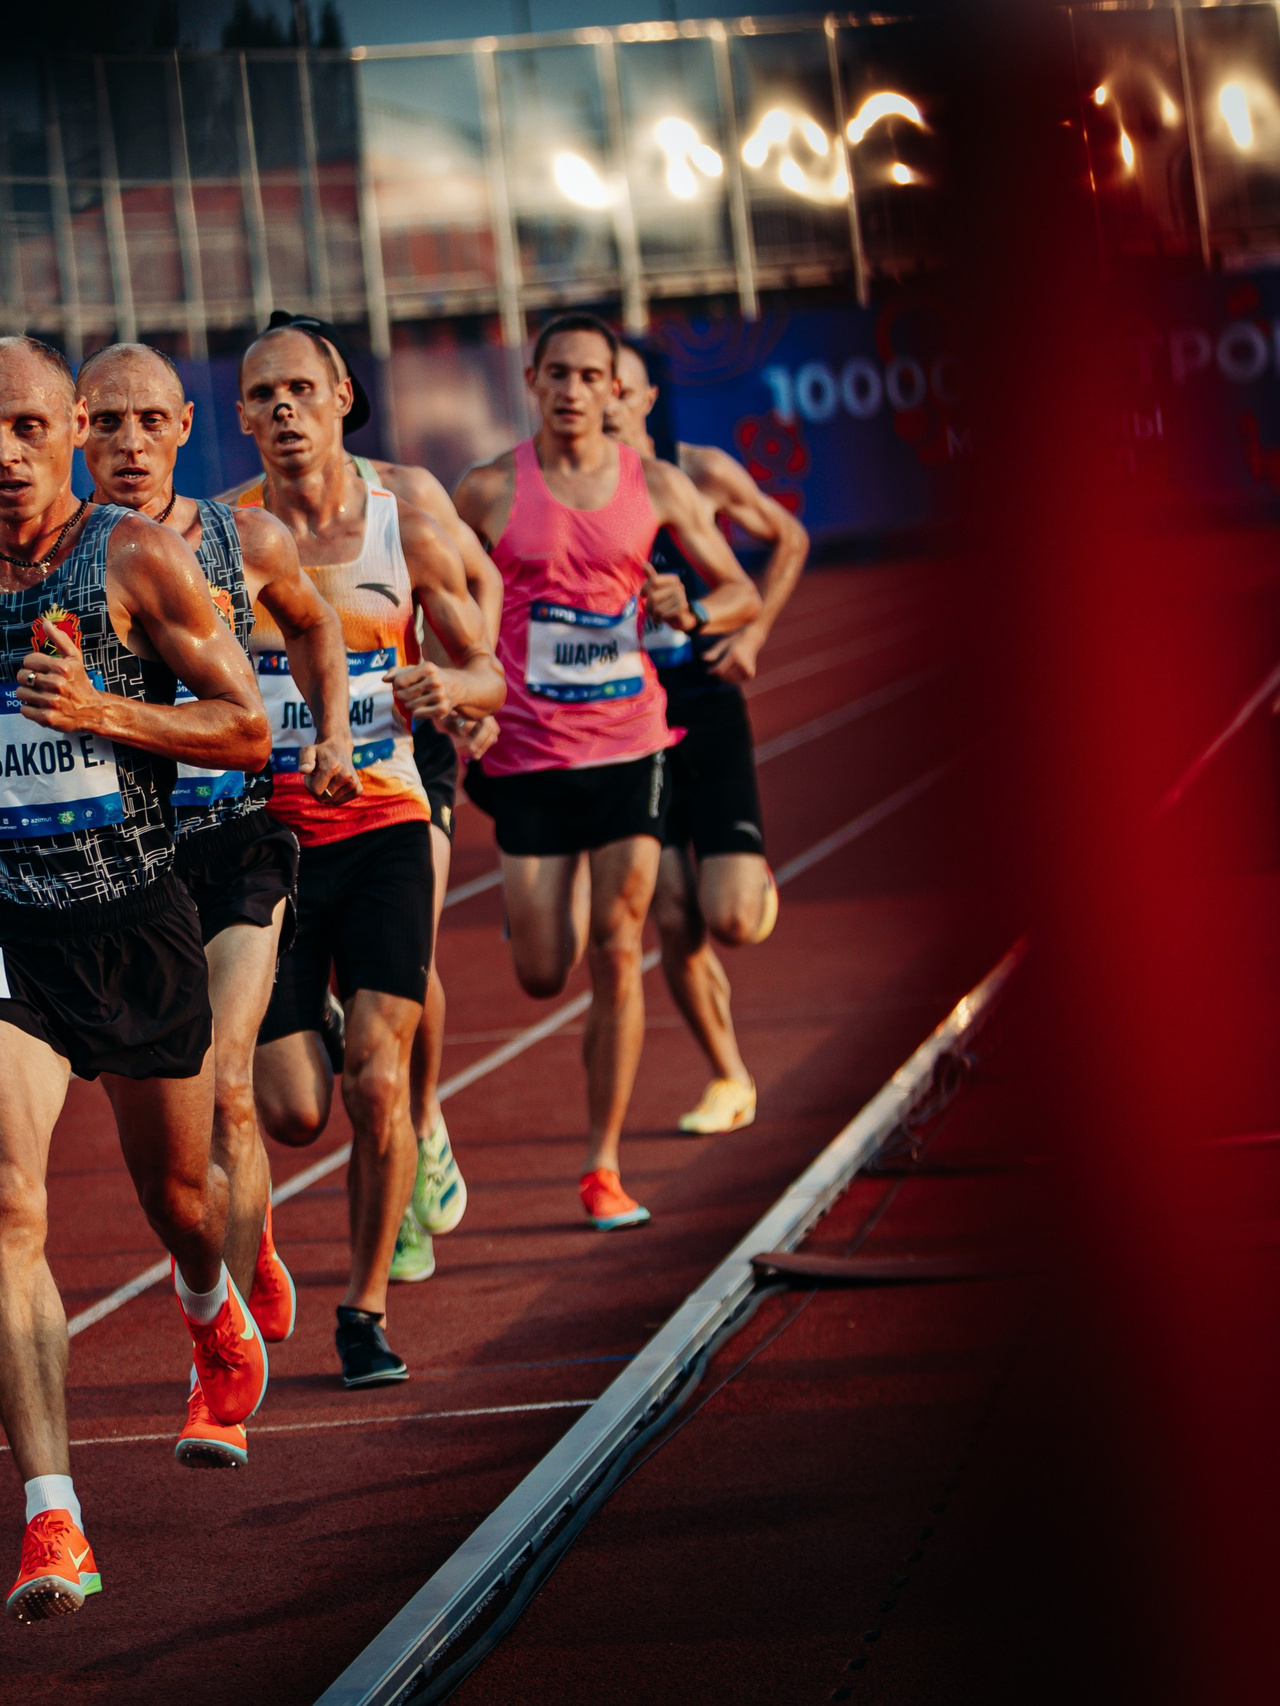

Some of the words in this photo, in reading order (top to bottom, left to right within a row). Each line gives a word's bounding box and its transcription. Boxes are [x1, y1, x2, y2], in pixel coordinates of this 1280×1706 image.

[281, 697, 374, 729] ЛЕАН
[79, 734, 105, 768] Е.
[30, 816, 53, 824] azimut
